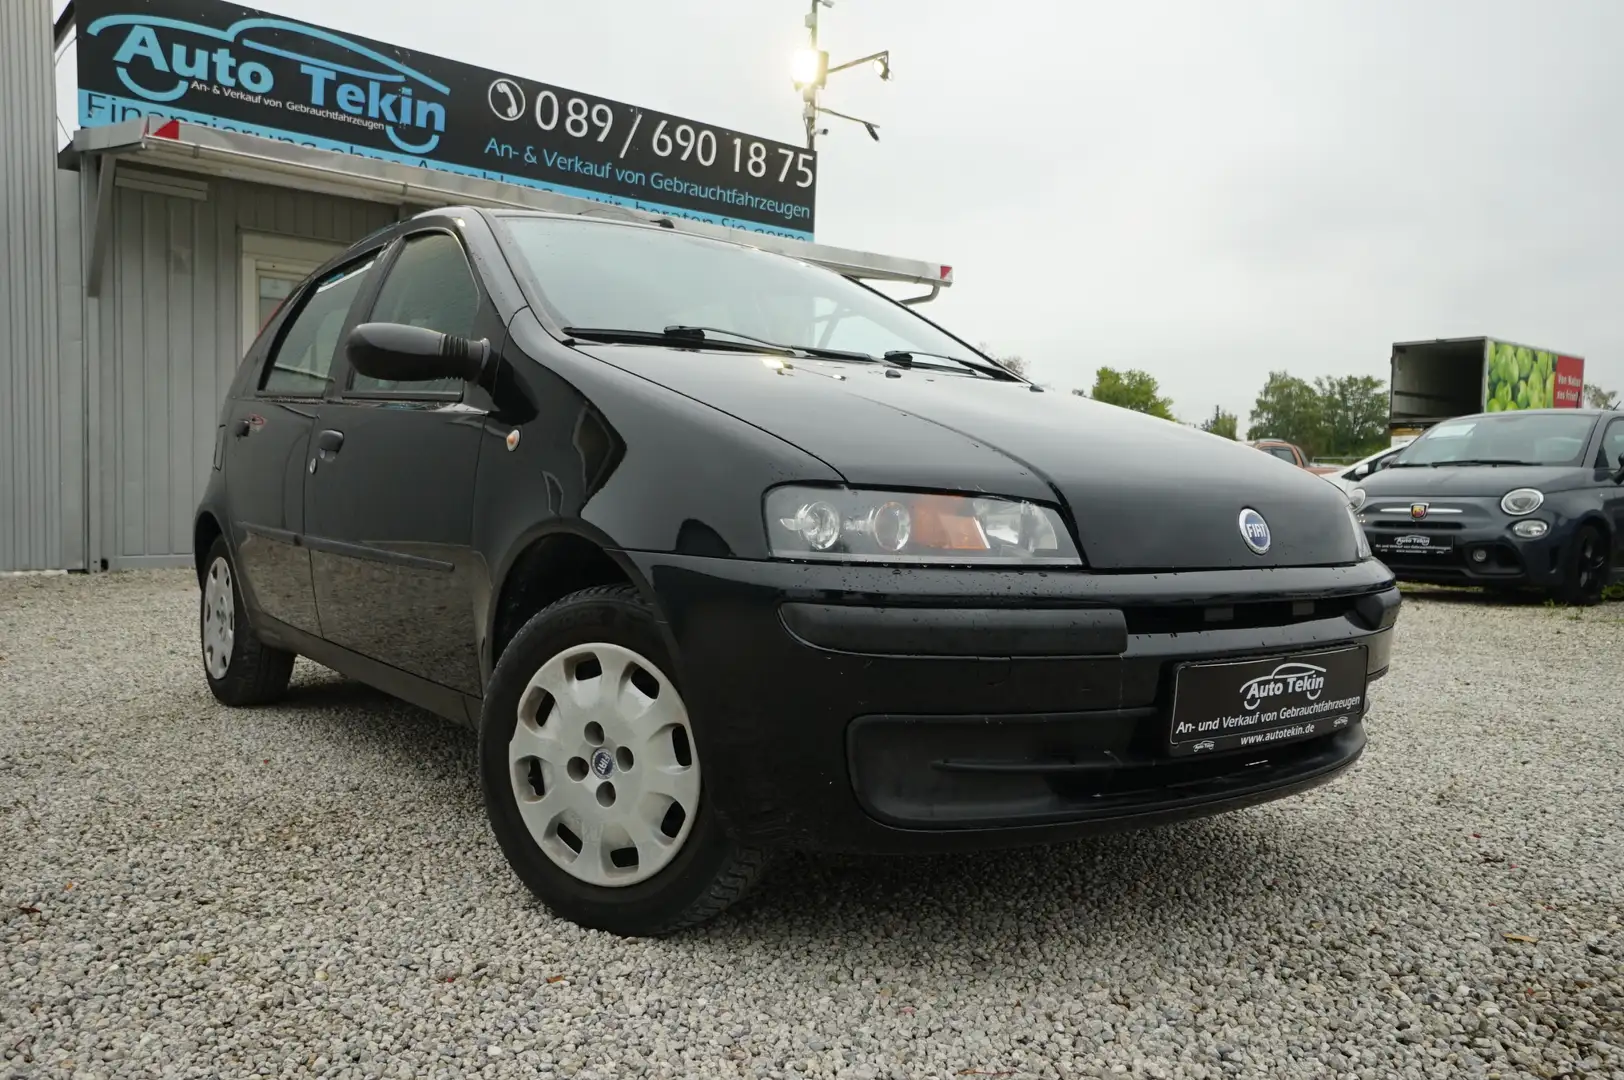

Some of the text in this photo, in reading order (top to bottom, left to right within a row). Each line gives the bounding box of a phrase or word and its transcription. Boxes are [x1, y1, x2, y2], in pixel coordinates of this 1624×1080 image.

[112, 24, 274, 93] Auto
[300, 63, 445, 133] Tekin
[190, 80, 385, 132] An- & Verkauf von Gebrauchtfahrzeugen
[535, 90, 814, 188] 089 / 690 18 75
[484, 137, 519, 158] An-
[524, 146, 538, 165] &
[542, 149, 612, 178] Verkauf
[615, 168, 646, 187] von
[650, 173, 811, 220] Gebrauchtfahrzeugen
[1246, 523, 1267, 538] FIAT
[1246, 674, 1325, 700] Auto Tekin
[1176, 695, 1361, 734] An- und Verkauf von Gebrauchtfahrzeugen
[1240, 723, 1315, 745] www.autotekin.de
[597, 753, 611, 775] FIAT
